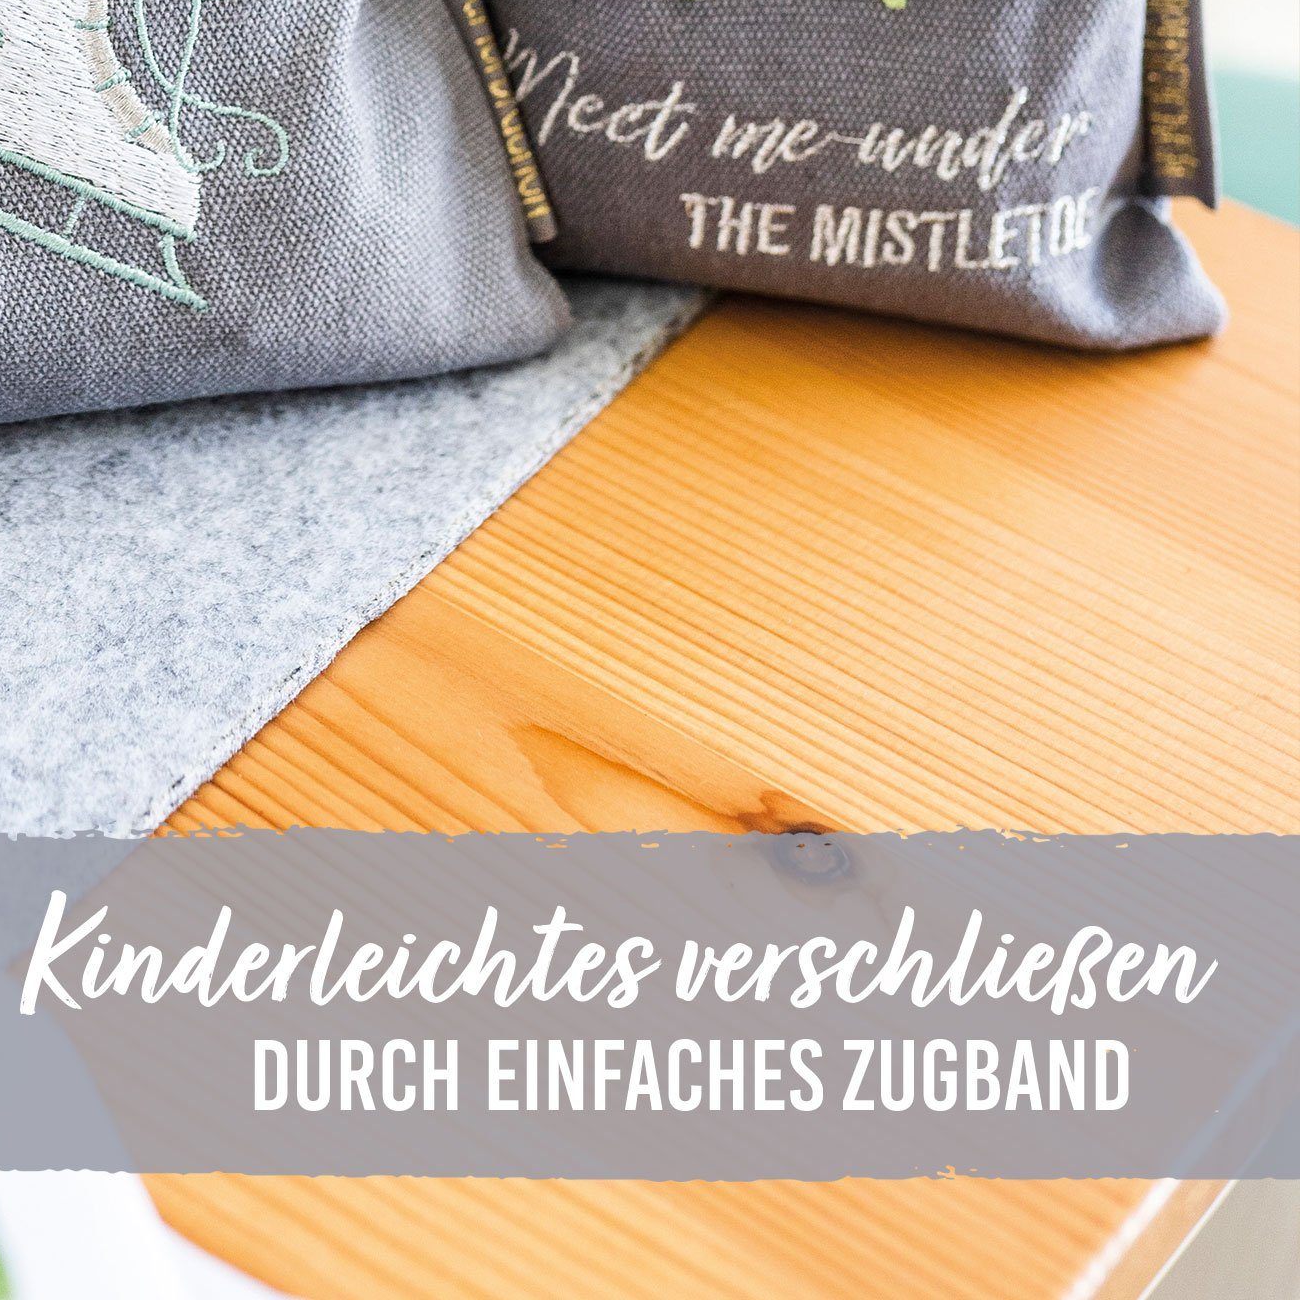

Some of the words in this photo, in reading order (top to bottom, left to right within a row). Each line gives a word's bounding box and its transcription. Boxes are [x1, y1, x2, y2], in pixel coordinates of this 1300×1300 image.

[503, 27, 699, 162] Meet
[711, 111, 833, 175] me
[856, 85, 1094, 192] under
[679, 192, 796, 256] THE
